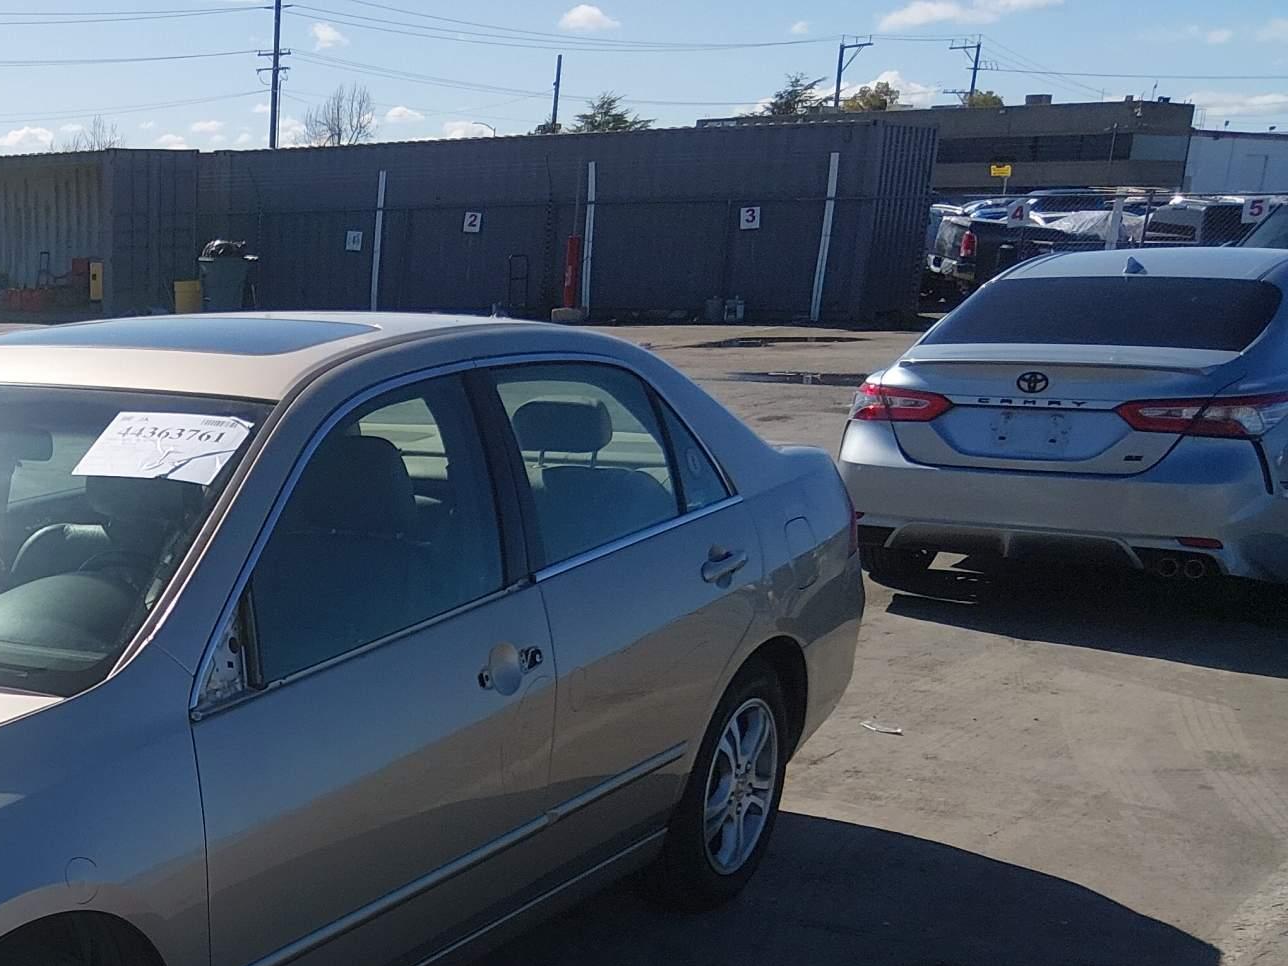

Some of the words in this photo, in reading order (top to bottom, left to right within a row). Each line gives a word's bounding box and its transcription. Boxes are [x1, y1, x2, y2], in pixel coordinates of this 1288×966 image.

[1012, 206, 1023, 220] 4
[1249, 200, 1263, 216] 5
[468, 213, 477, 227] 2
[745, 209, 755, 223] 3
[977, 397, 1089, 407] CAMRY
[117, 426, 226, 444] 44363761
